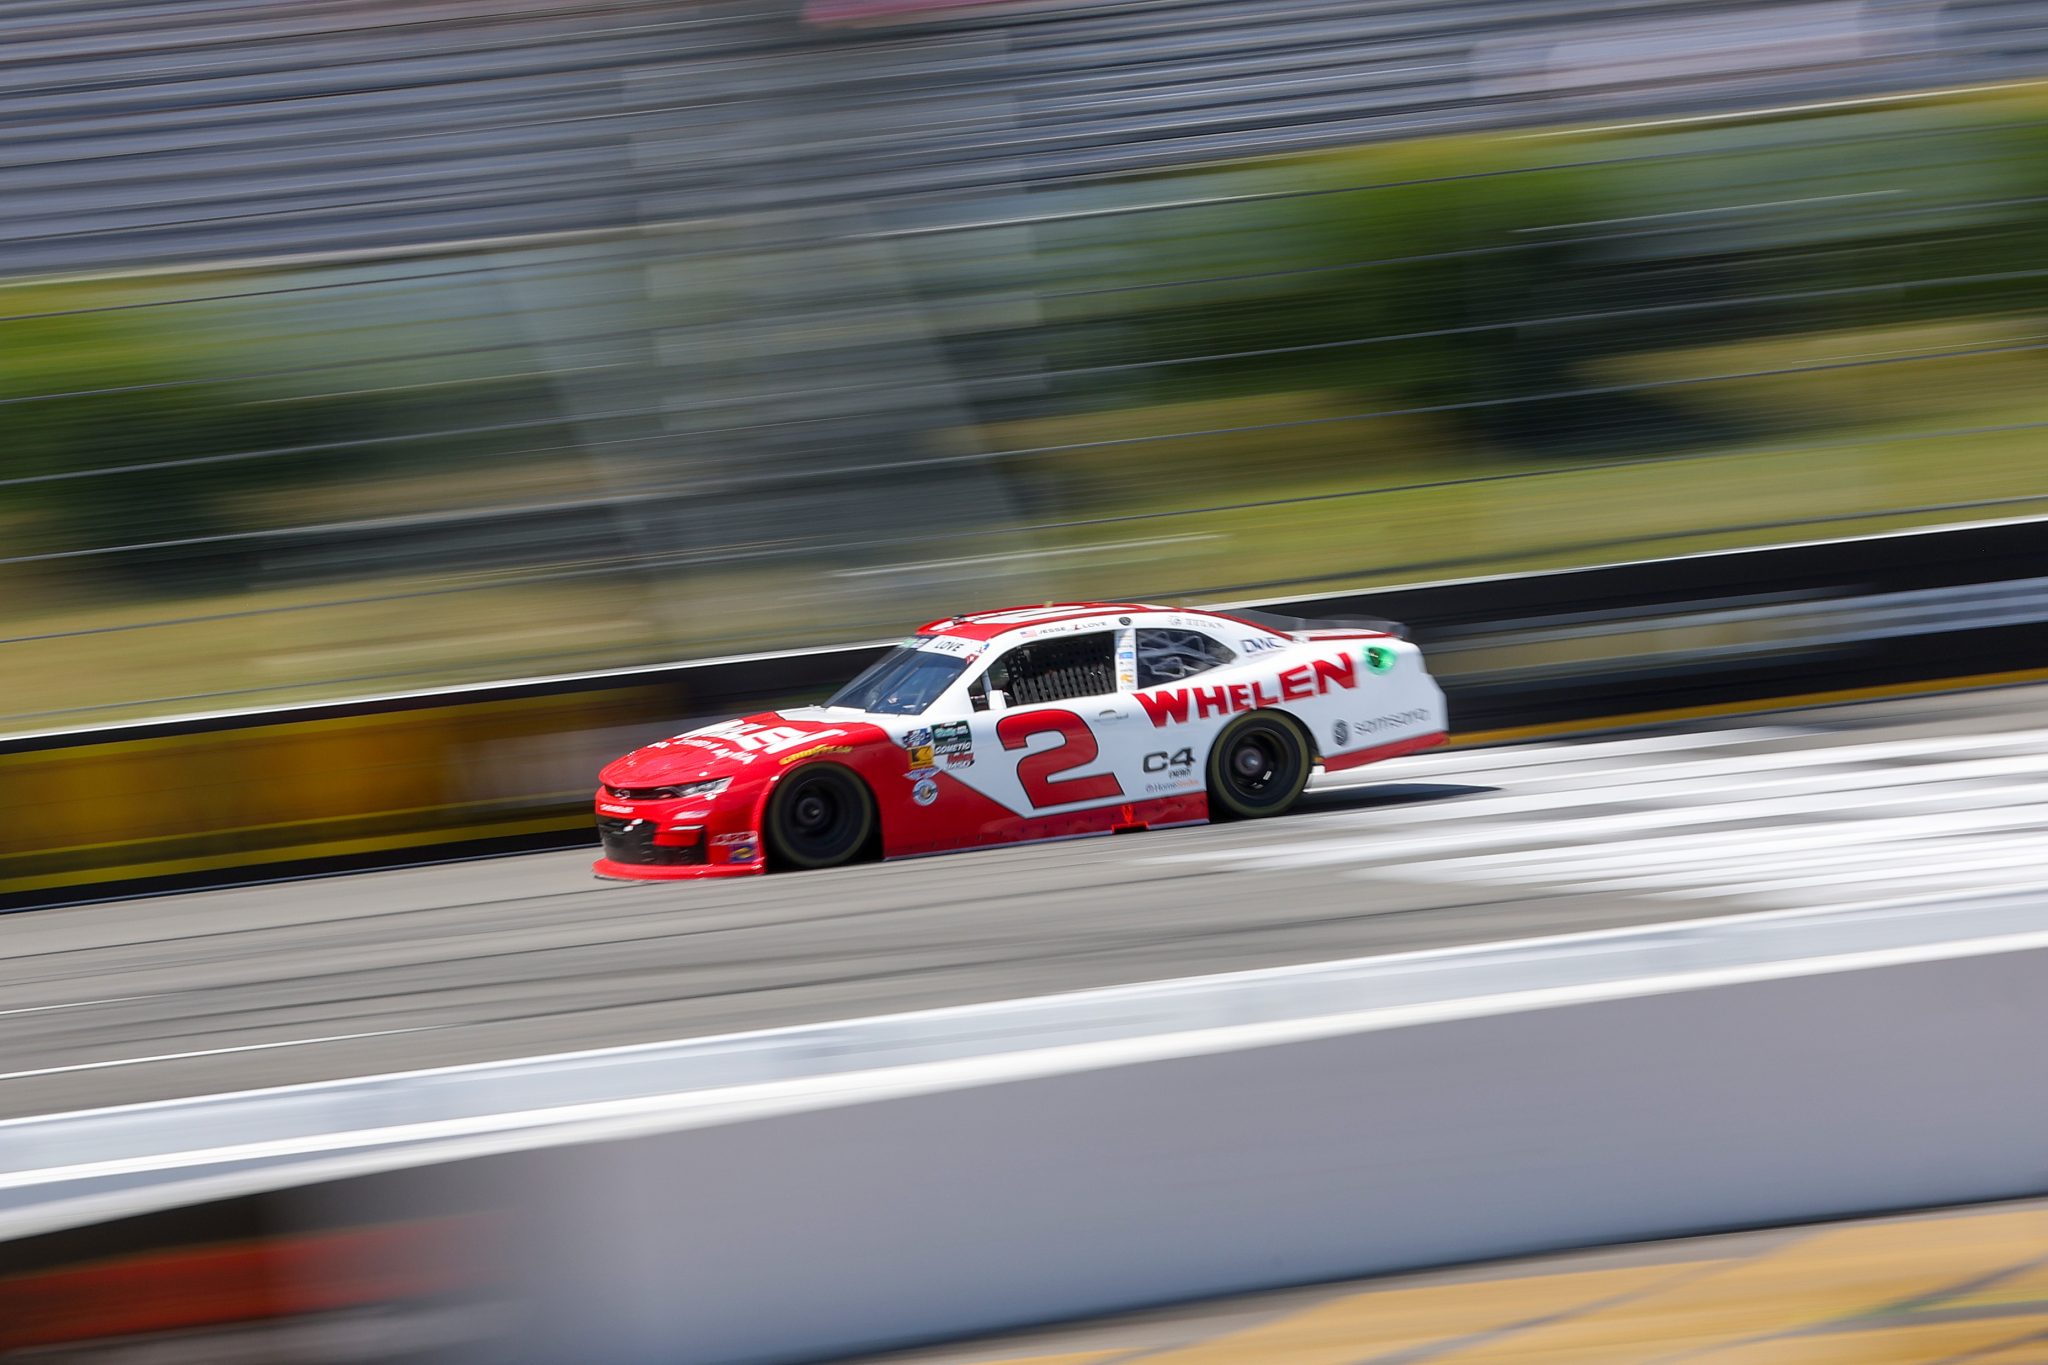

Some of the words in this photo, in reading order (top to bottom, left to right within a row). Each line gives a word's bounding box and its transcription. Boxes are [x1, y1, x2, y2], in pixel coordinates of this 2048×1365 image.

[933, 640, 965, 652] LOVE
[1132, 652, 1358, 729] WHELEN
[996, 709, 1126, 810] 2
[1143, 747, 1197, 774] C4
